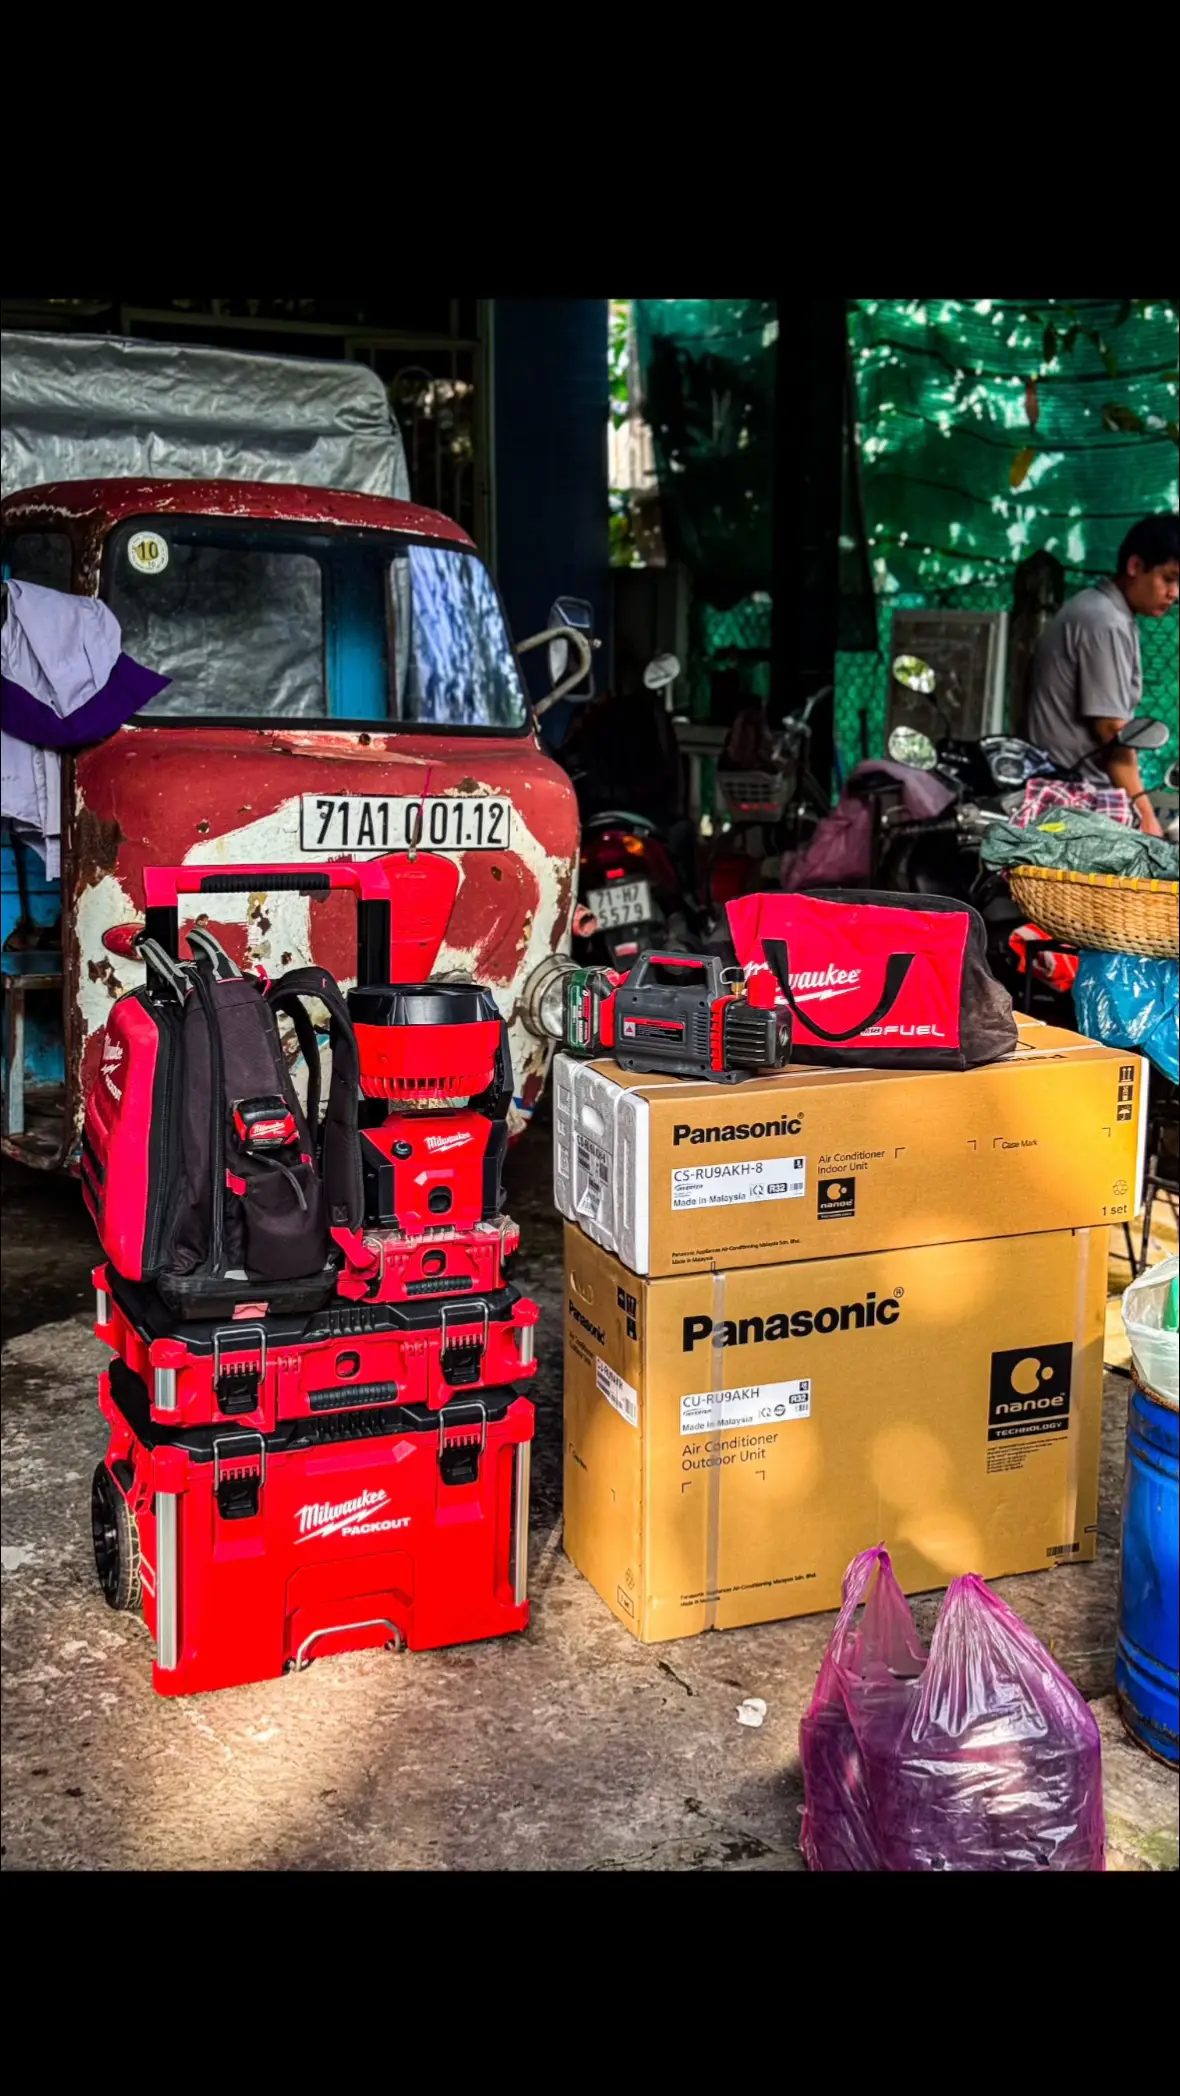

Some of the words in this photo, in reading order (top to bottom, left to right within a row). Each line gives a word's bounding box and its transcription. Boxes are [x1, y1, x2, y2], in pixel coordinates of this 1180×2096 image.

[138, 541, 158, 560] 10
[316, 800, 389, 846] 71A1
[405, 801, 504, 845] 001.12
[598, 902, 643, 928] 5579
[884, 1024, 945, 1037] FUEL
[673, 1115, 802, 1146] Panasonic
[424, 1131, 471, 1150] Milwaukee
[1001, 1141, 1020, 1149] Case
[1021, 1139, 1037, 1147] Mark
[818, 1154, 831, 1164] Air
[834, 1149, 885, 1163] Conditioner
[674, 1163, 763, 1182] CS-RU9AKH-8
[817, 1164, 847, 1175] Indoor
[849, 1162, 869, 1171] Unit
[768, 1183, 786, 1193] R32
[674, 1198, 696, 1207] Made
[699, 1197, 707, 1205] in
[708, 1193, 746, 1204] Malaysia
[820, 1200, 853, 1209] nanoe
[1102, 1207, 1107, 1216] 1
[1110, 1204, 1128, 1215] set
[569, 1299, 606, 1346] Panasonic
[683, 1292, 899, 1352] Panasonic
[683, 1387, 760, 1407] CU-RU9AKH
[995, 1396, 1064, 1415] nanoe
[682, 1422, 704, 1431] Made
[717, 1416, 753, 1426] Malaysia
[995, 1421, 1063, 1437] TECHNOLOGY
[682, 1445, 701, 1456] Air
[704, 1433, 779, 1453] Conditioner
[681, 1455, 736, 1471] Outdoor
[740, 1449, 766, 1462] Unit
[294, 1489, 387, 1533] Milwaukee
[341, 1517, 411, 1537] PACKOUT
